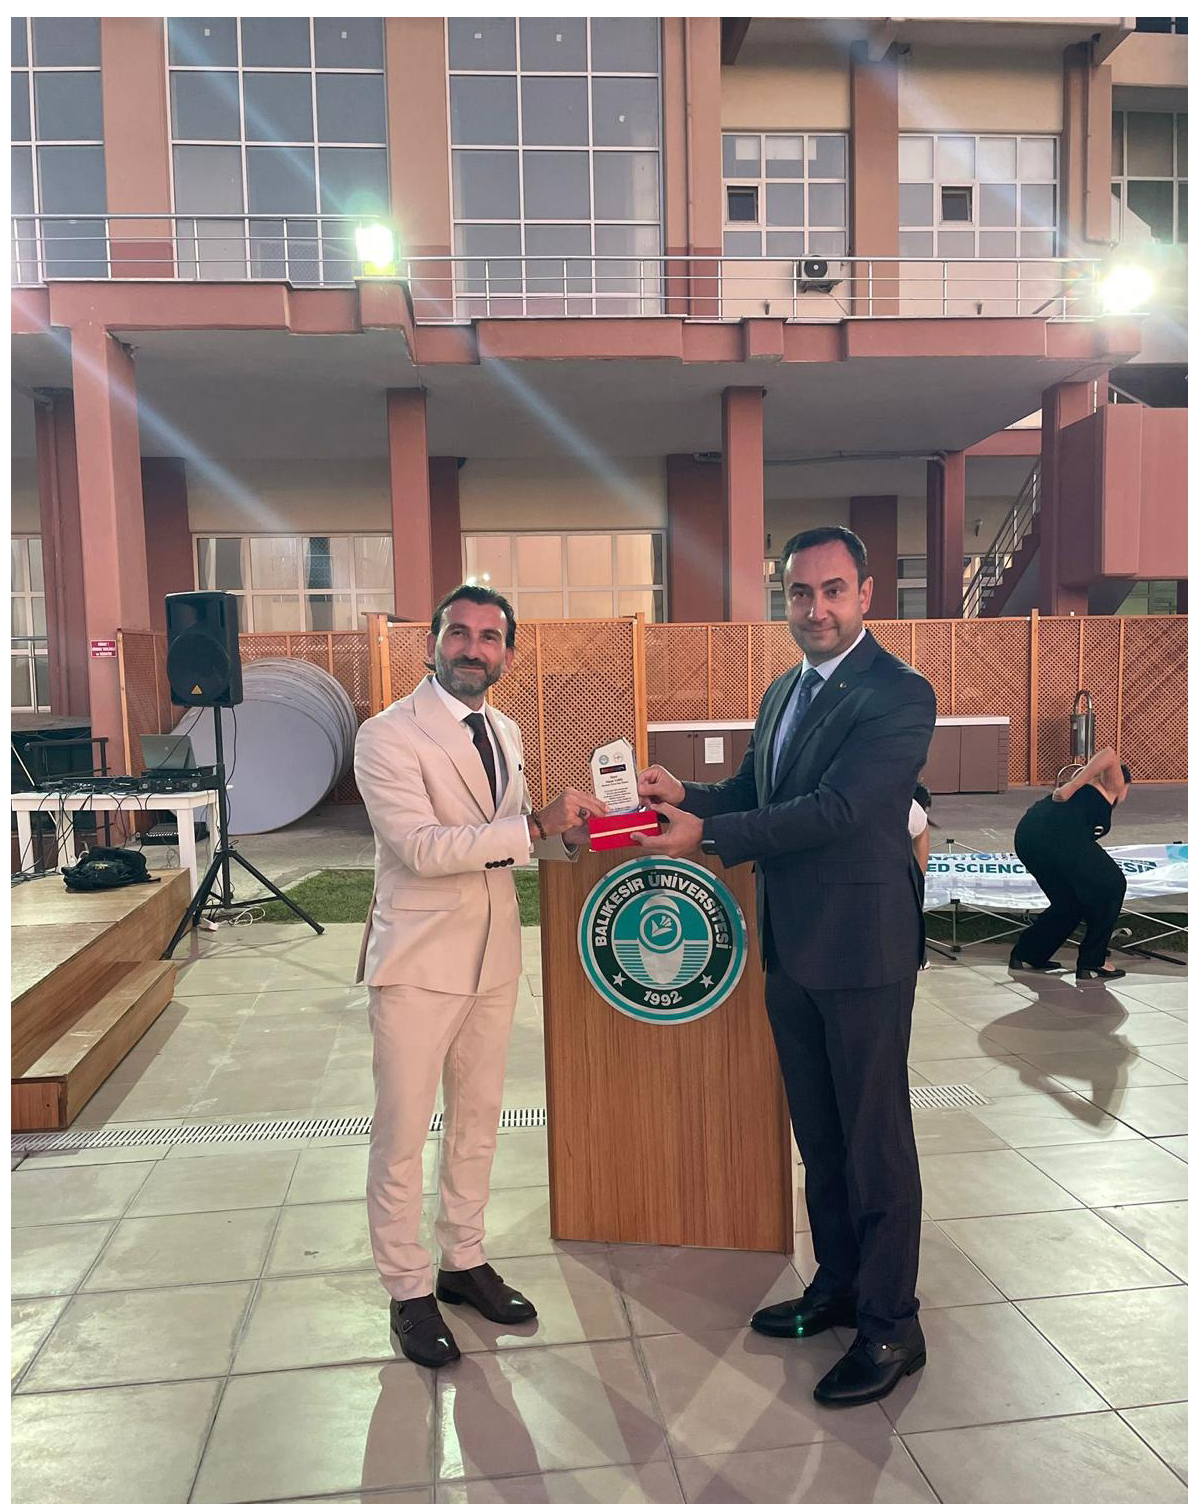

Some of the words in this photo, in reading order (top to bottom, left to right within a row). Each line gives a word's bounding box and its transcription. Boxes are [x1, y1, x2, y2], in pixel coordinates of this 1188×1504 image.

[955, 863, 1029, 874] SCIENC
[595, 877, 645, 948] BALIKESİR
[648, 872, 732, 950] ÜNİVERSİTESİ
[643, 990, 684, 1007] 1992
